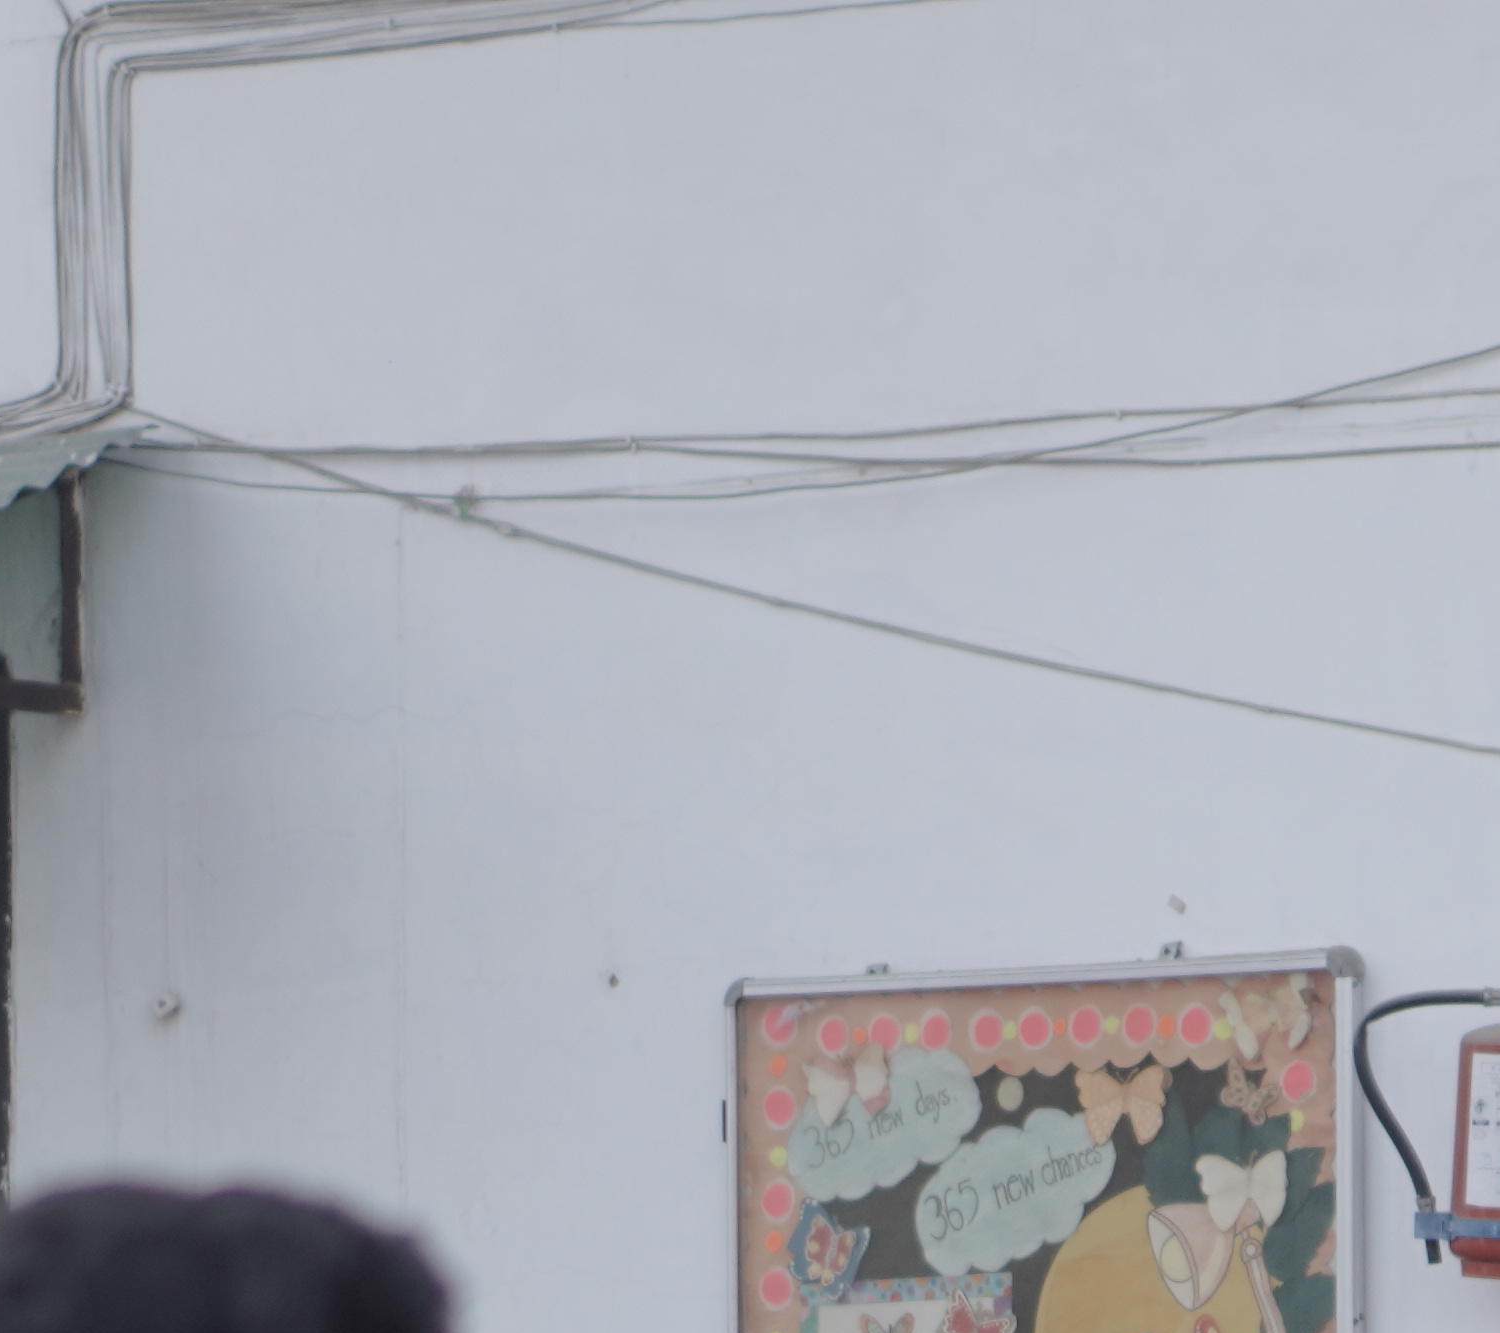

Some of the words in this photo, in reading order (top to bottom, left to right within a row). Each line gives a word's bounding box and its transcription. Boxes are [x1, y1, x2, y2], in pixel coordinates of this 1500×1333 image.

[804, 1116, 856, 1170] 365
[866, 1110, 905, 1140] new
[923, 1179, 980, 1242] 365
[991, 1172, 1037, 1210] new
[1041, 1143, 1104, 1187] chances
